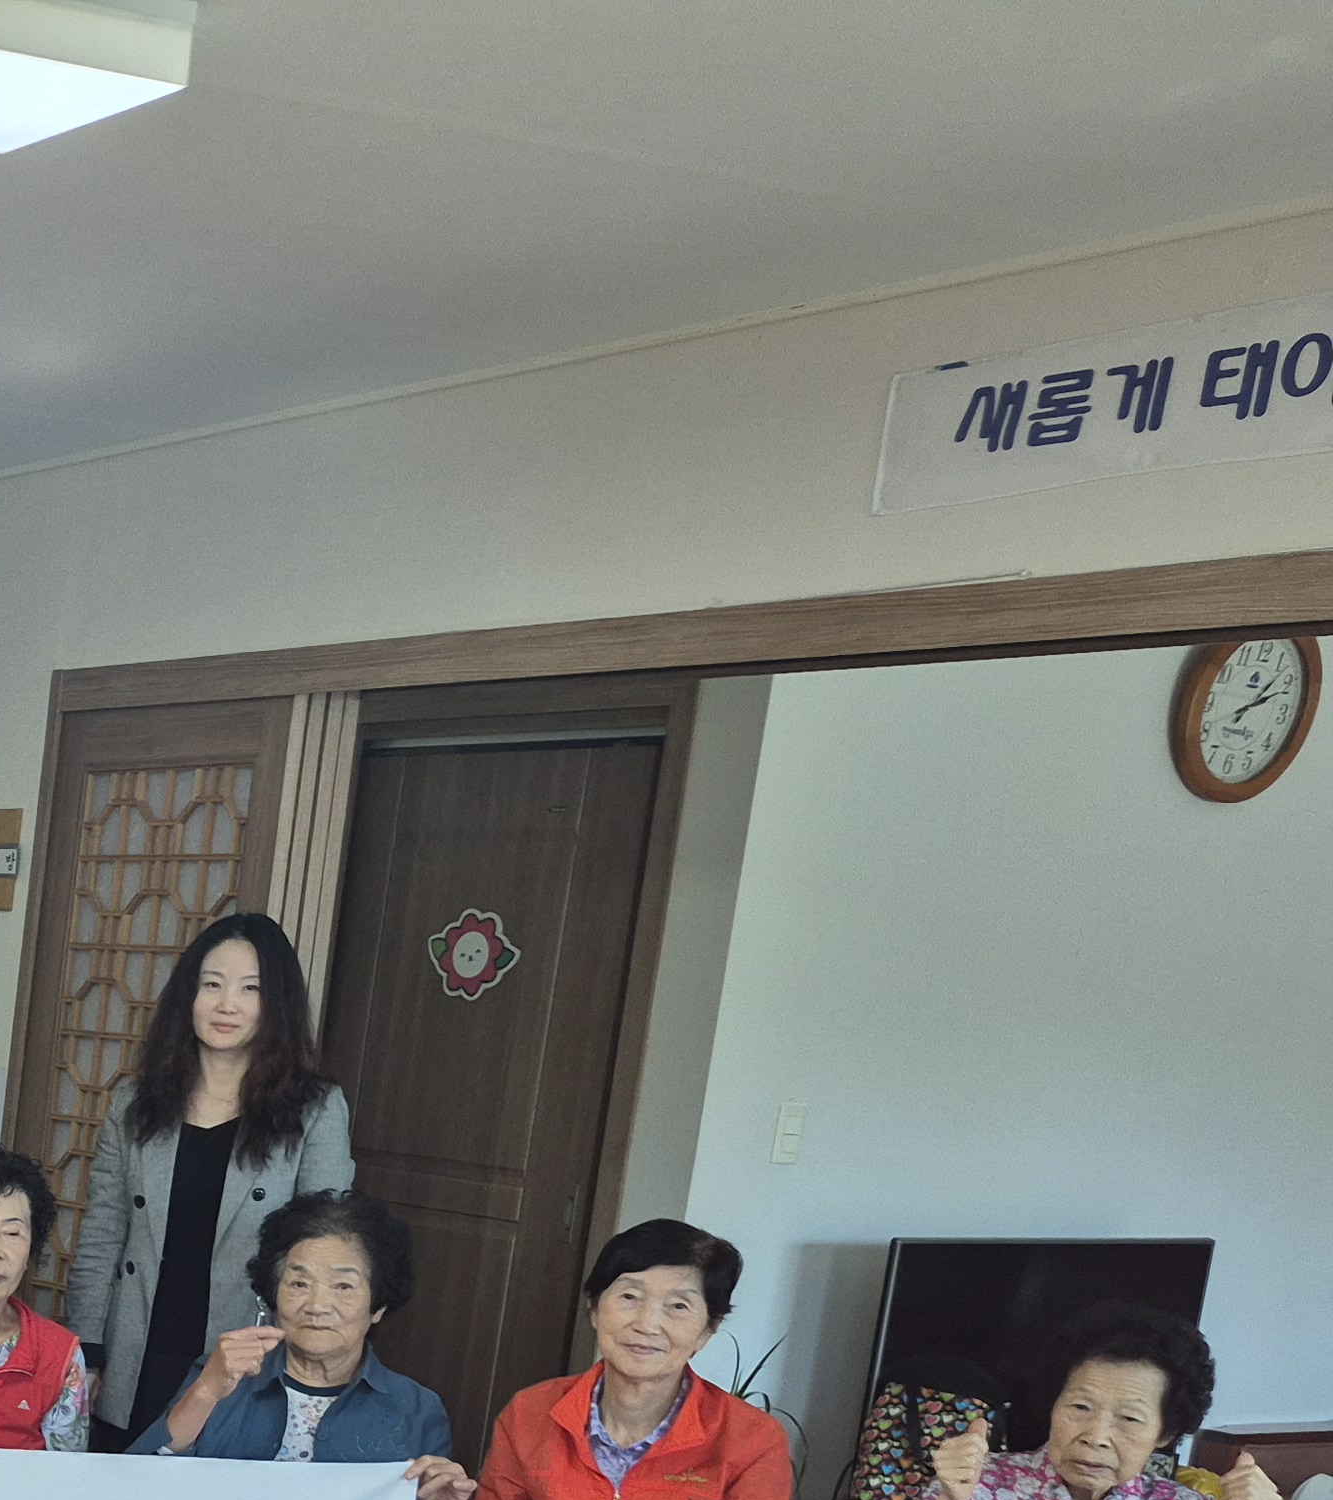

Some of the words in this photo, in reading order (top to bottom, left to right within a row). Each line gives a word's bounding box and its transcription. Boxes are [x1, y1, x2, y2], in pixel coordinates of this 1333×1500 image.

[1236, 645, 1252, 666] 11
[1256, 642, 1273, 662] 12
[1276, 704, 1288, 724] 3
[1261, 732, 1273, 751] 4
[1208, 745, 1220, 764] 7
[1223, 754, 1233, 774] 6
[5, 852, 16, 871] 방
